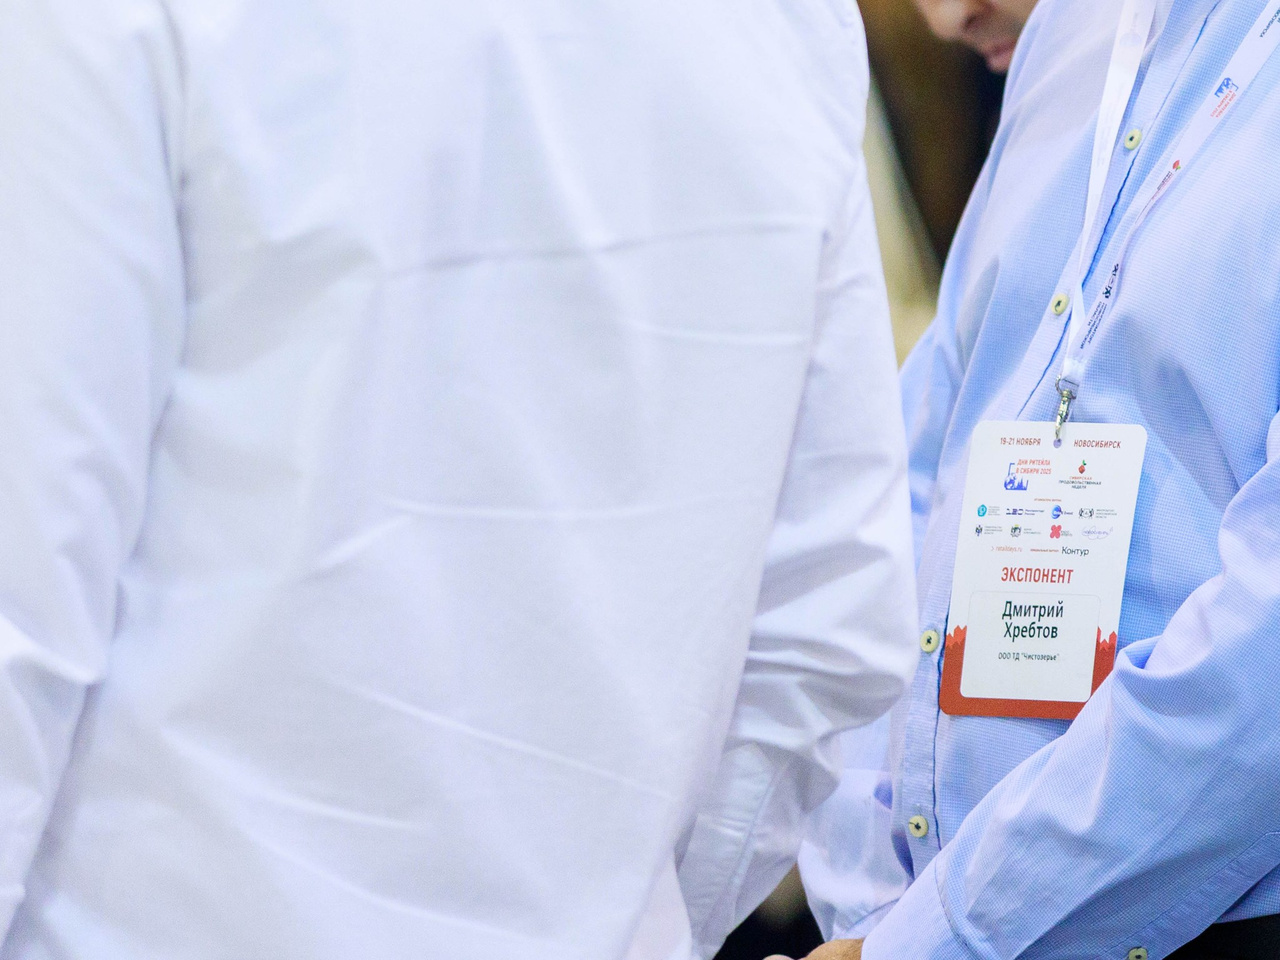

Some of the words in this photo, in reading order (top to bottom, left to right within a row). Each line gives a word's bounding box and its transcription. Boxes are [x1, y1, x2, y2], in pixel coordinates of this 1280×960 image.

[1000, 437, 1014, 445] 19-21
[1016, 438, 1041, 446] НОЯБРЯ
[1073, 440, 1121, 449] НОВОСИБИРСК
[1029, 458, 1051, 466] РИТЕЙЛА
[1061, 546, 1089, 557] Контур
[1001, 567, 1074, 584] ЭКСПОНЕНТ
[1002, 600, 1064, 622] Дмитрий
[1003, 621, 1058, 643] Хребтов
[998, 652, 1011, 660] ООО
[1012, 652, 1020, 661] ТД
